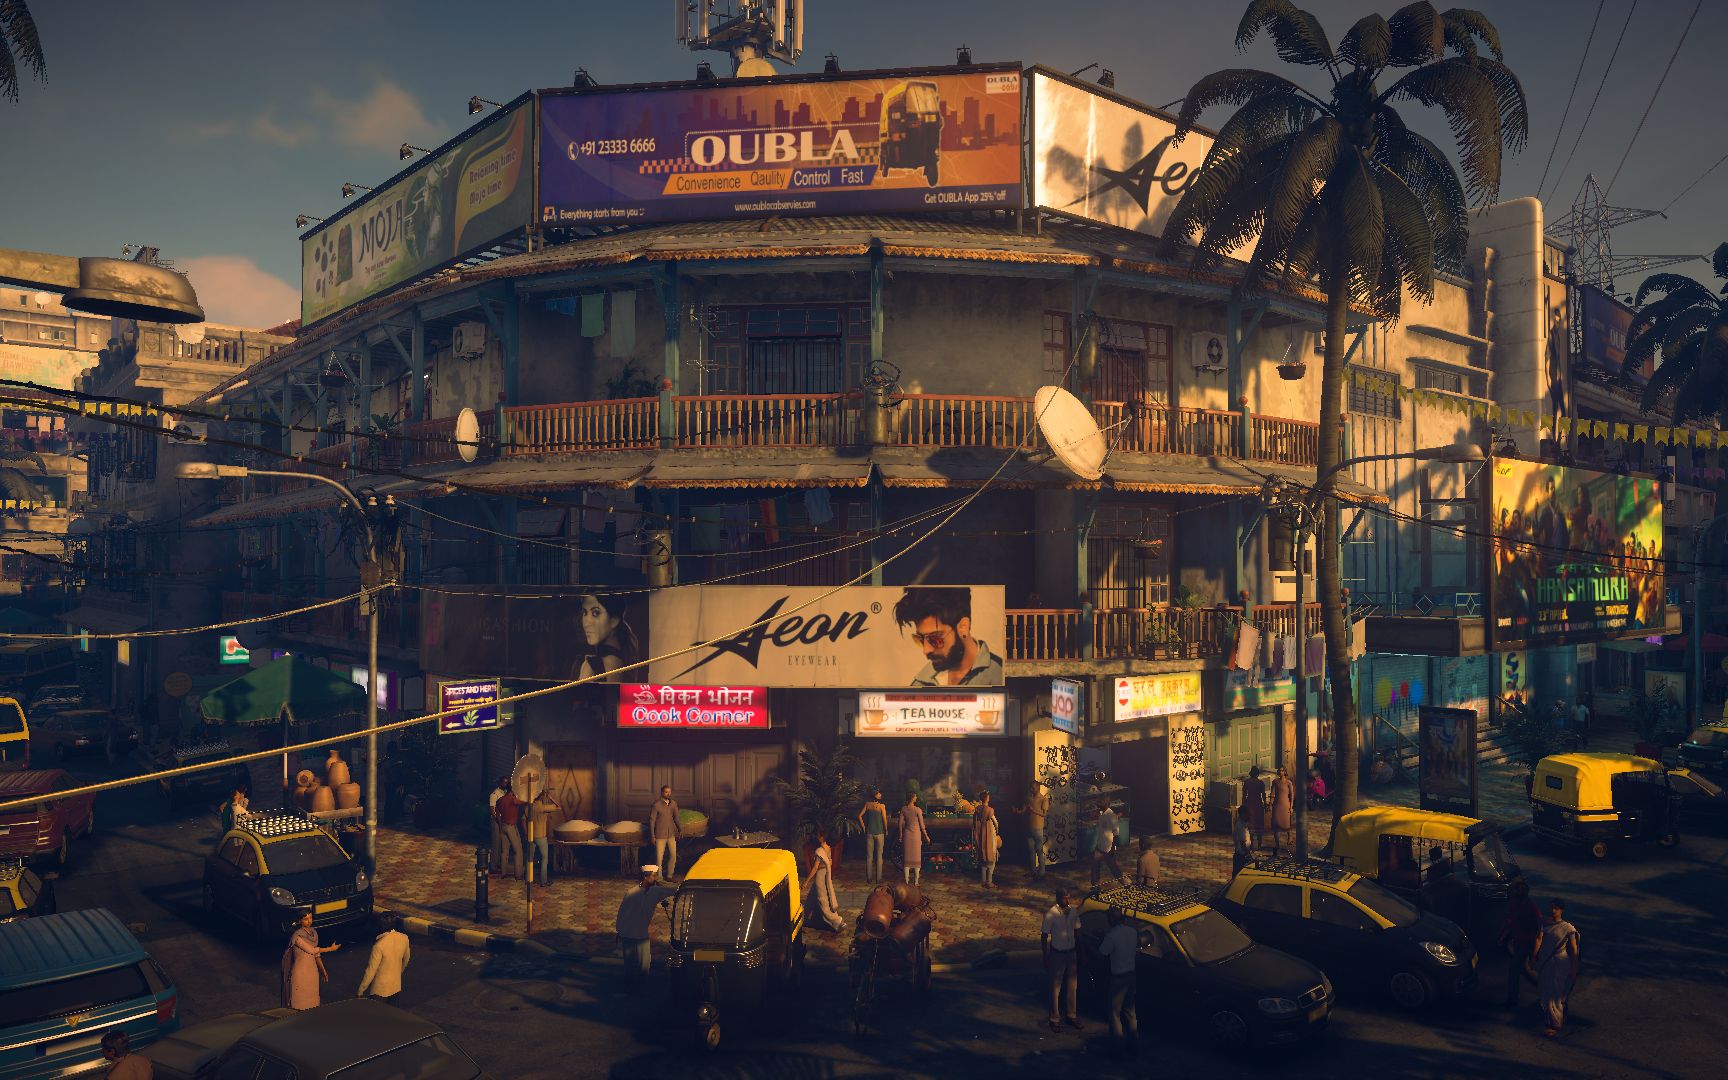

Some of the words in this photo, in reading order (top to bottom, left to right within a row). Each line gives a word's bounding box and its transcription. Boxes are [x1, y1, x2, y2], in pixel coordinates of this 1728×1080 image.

[580, 141, 596, 155] +91
[598, 140, 628, 154] 23333
[630, 138, 656, 153] 6666
[691, 129, 859, 167] OUBLA
[676, 173, 741, 192] Convenience
[793, 169, 831, 187] Control
[841, 168, 864, 184] Fast
[924, 192, 937, 204] Get
[937, 191, 963, 203] OUBLA
[964, 190, 979, 204] App
[560, 208, 593, 221] Everything
[594, 207, 610, 219] starts
[611, 207, 626, 218] from
[626, 209, 639, 220] you
[359, 198, 403, 264] MOJA
[666, 595, 869, 682] Aeon
[788, 655, 837, 666] EYEWEAR
[707, 686, 754, 706] भोजन
[633, 706, 681, 724] Cook
[686, 707, 755, 725] Corner
[900, 708, 926, 720] TEA
[929, 708, 966, 720] HOUSE
